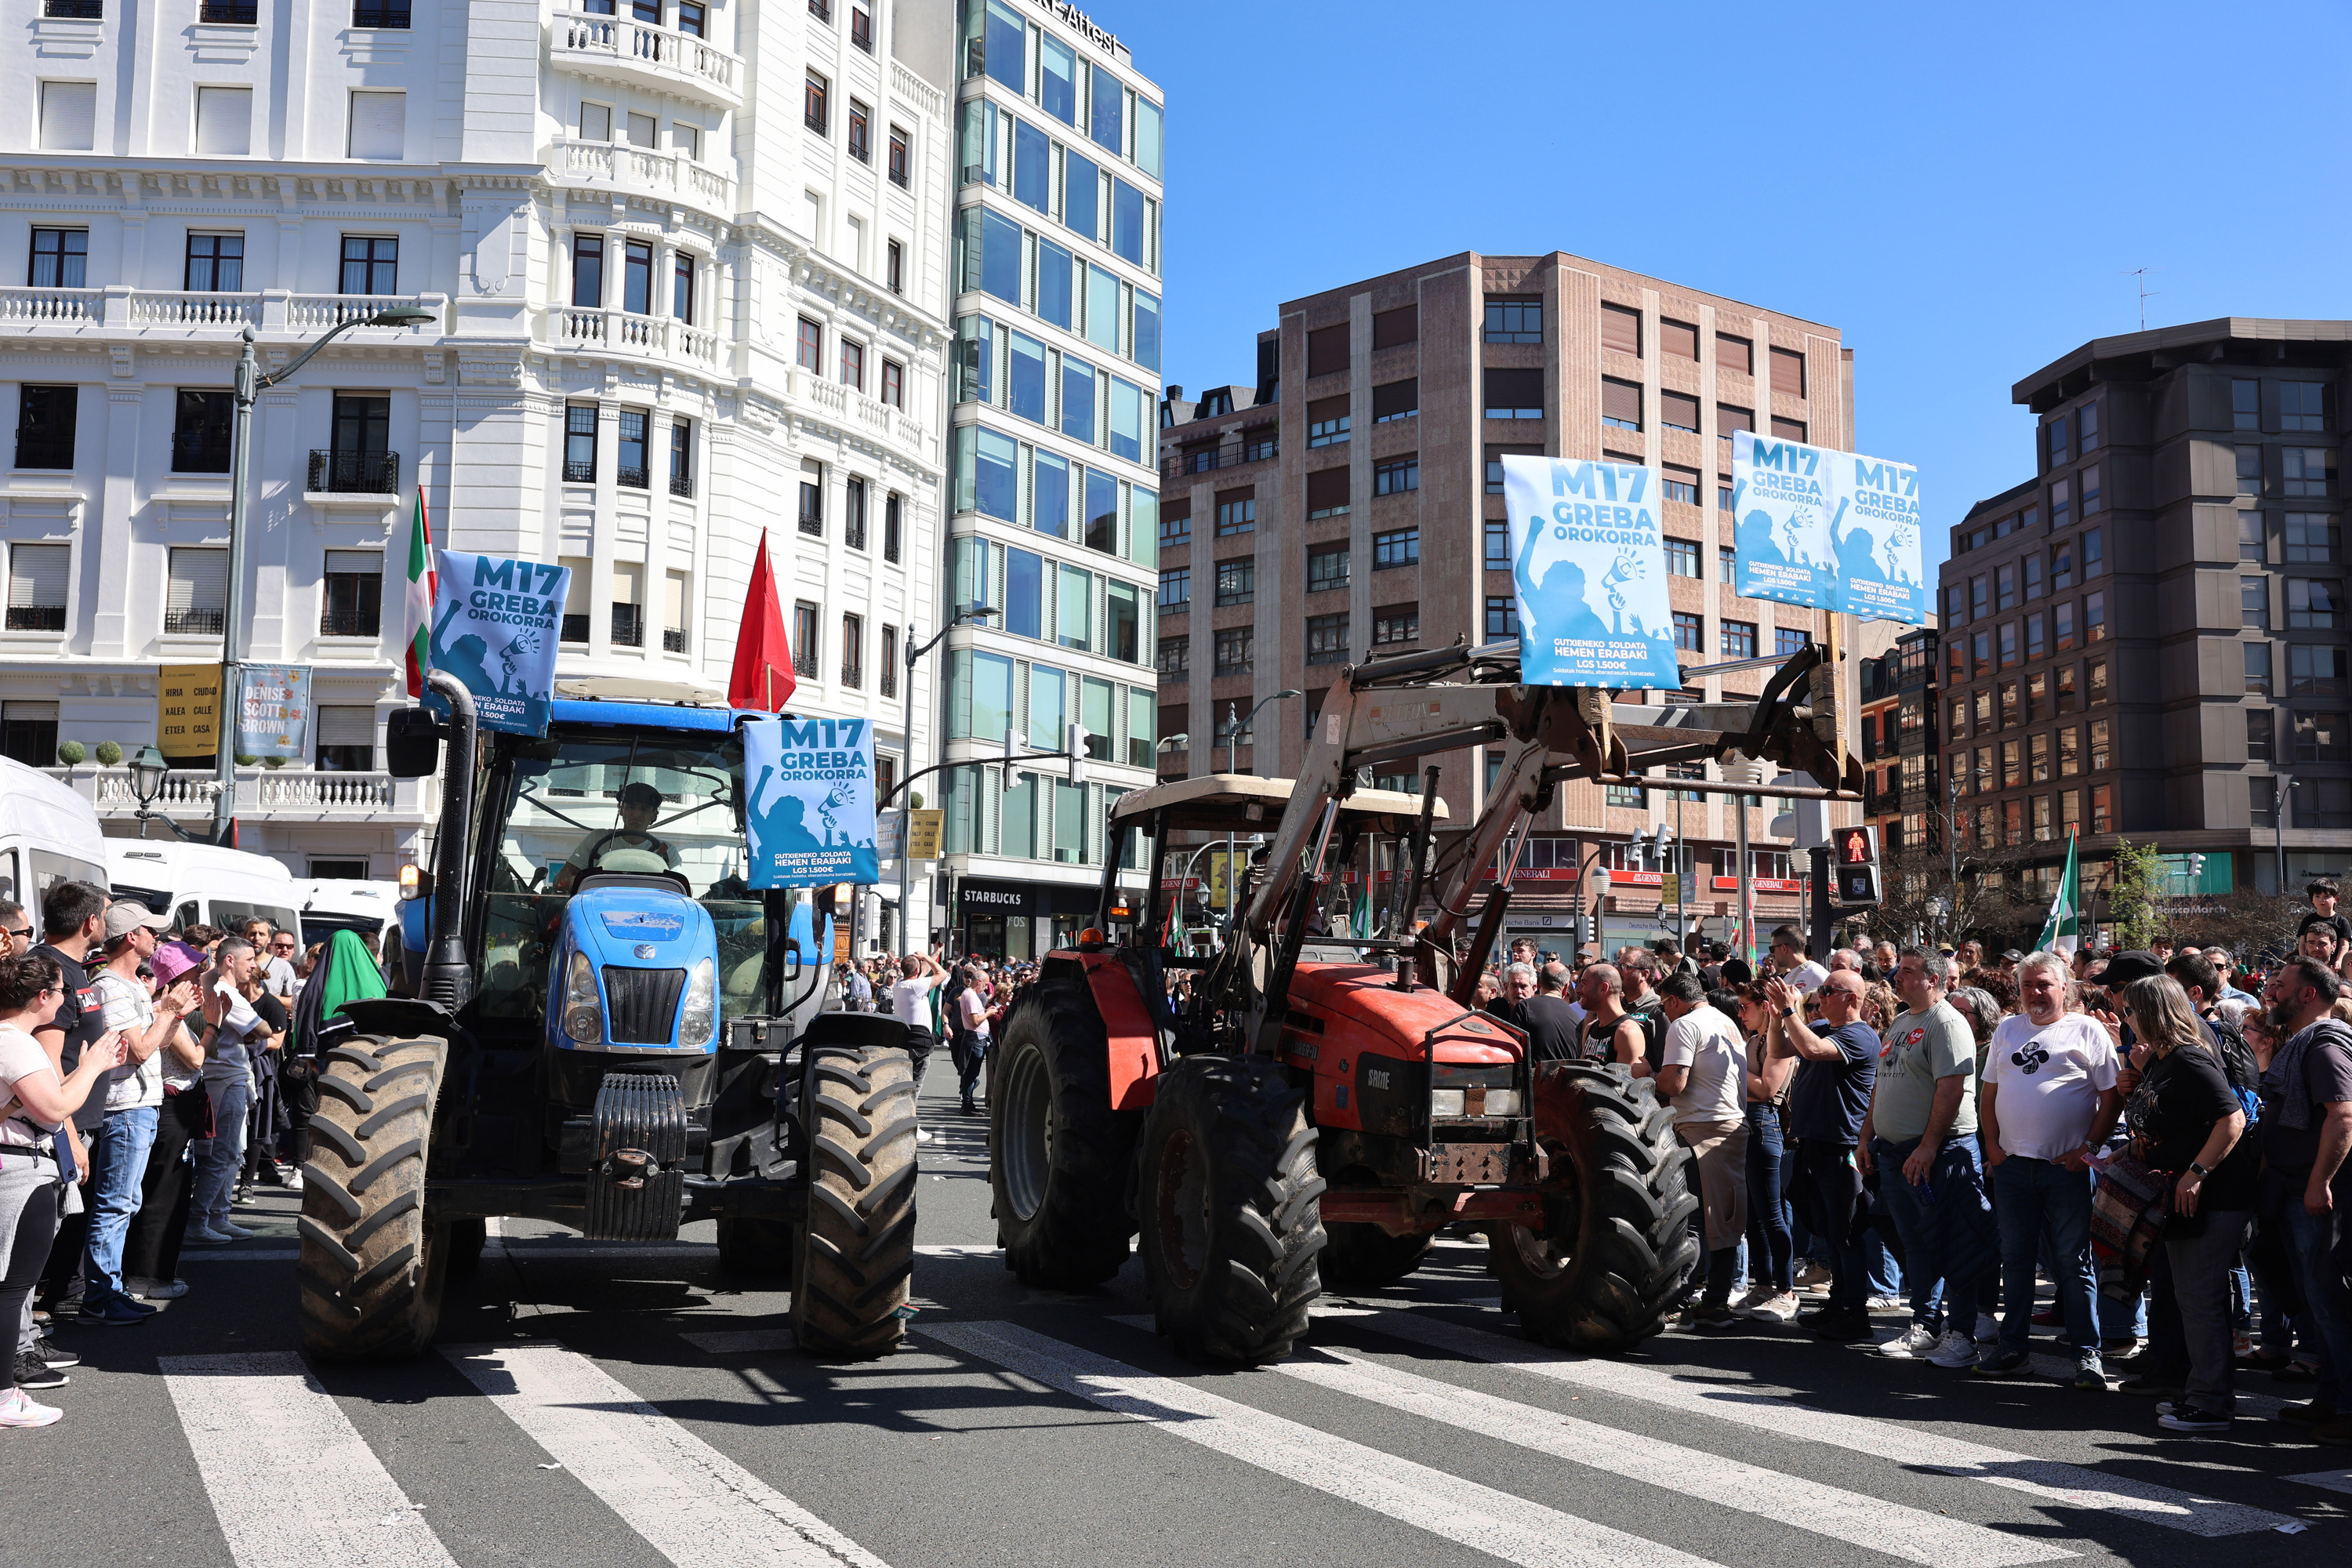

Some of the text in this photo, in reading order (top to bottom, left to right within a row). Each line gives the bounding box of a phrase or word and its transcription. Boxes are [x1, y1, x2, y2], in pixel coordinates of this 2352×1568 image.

[1066, 3, 1119, 58] Attest
[1753, 438, 1820, 477] M17
[1548, 457, 1649, 503] M17
[1752, 470, 1823, 496] GREBA
[1855, 459, 1918, 497] M17
[1752, 487, 1823, 507] OROKORRA
[1855, 489, 1919, 515] GREBA
[1552, 501, 1656, 532] GREBA
[1855, 505, 1920, 525] OROKORRA
[1554, 526, 1657, 546] OROKORRA
[474, 555, 563, 596] M17
[1749, 566, 1811, 582] HEMEN ERABAKI
[1785, 566, 1811, 575] SOLDATA
[1850, 583, 1910, 600] HEMEN ERABAKI
[1886, 584, 1910, 593] SOLDATA
[470, 590, 557, 618] GREBA
[468, 608, 555, 630] OROKORRA
[1554, 638, 1647, 650] GUTXIENEKO SOLDATA
[1555, 646, 1647, 659] HEMEN ERABAKI
[1577, 659, 1627, 670] LGS 1.500€
[165, 687, 217, 697] HIRIA CIUDAD
[245, 686, 285, 701] DENISE
[243, 702, 282, 717] SCOTT
[484, 702, 525, 714] ERABAKI
[495, 698, 525, 706] SOLDATA
[165, 706, 212, 716] KALEA CALLE
[481, 710, 506, 720] 1.500€
[165, 724, 210, 735] ETXEA CASA
[241, 719, 285, 734] BROWN
[781, 719, 865, 749] M17
[780, 750, 868, 769] GREBA
[780, 769, 867, 781] OROKORRA
[877, 832, 891, 840] SCOTT
[1514, 869, 1551, 878] ENERALI
[1755, 880, 1783, 889] GENERALI
[964, 890, 1022, 905] STARBUCKS
[1368, 1069, 1390, 1091] SAME
